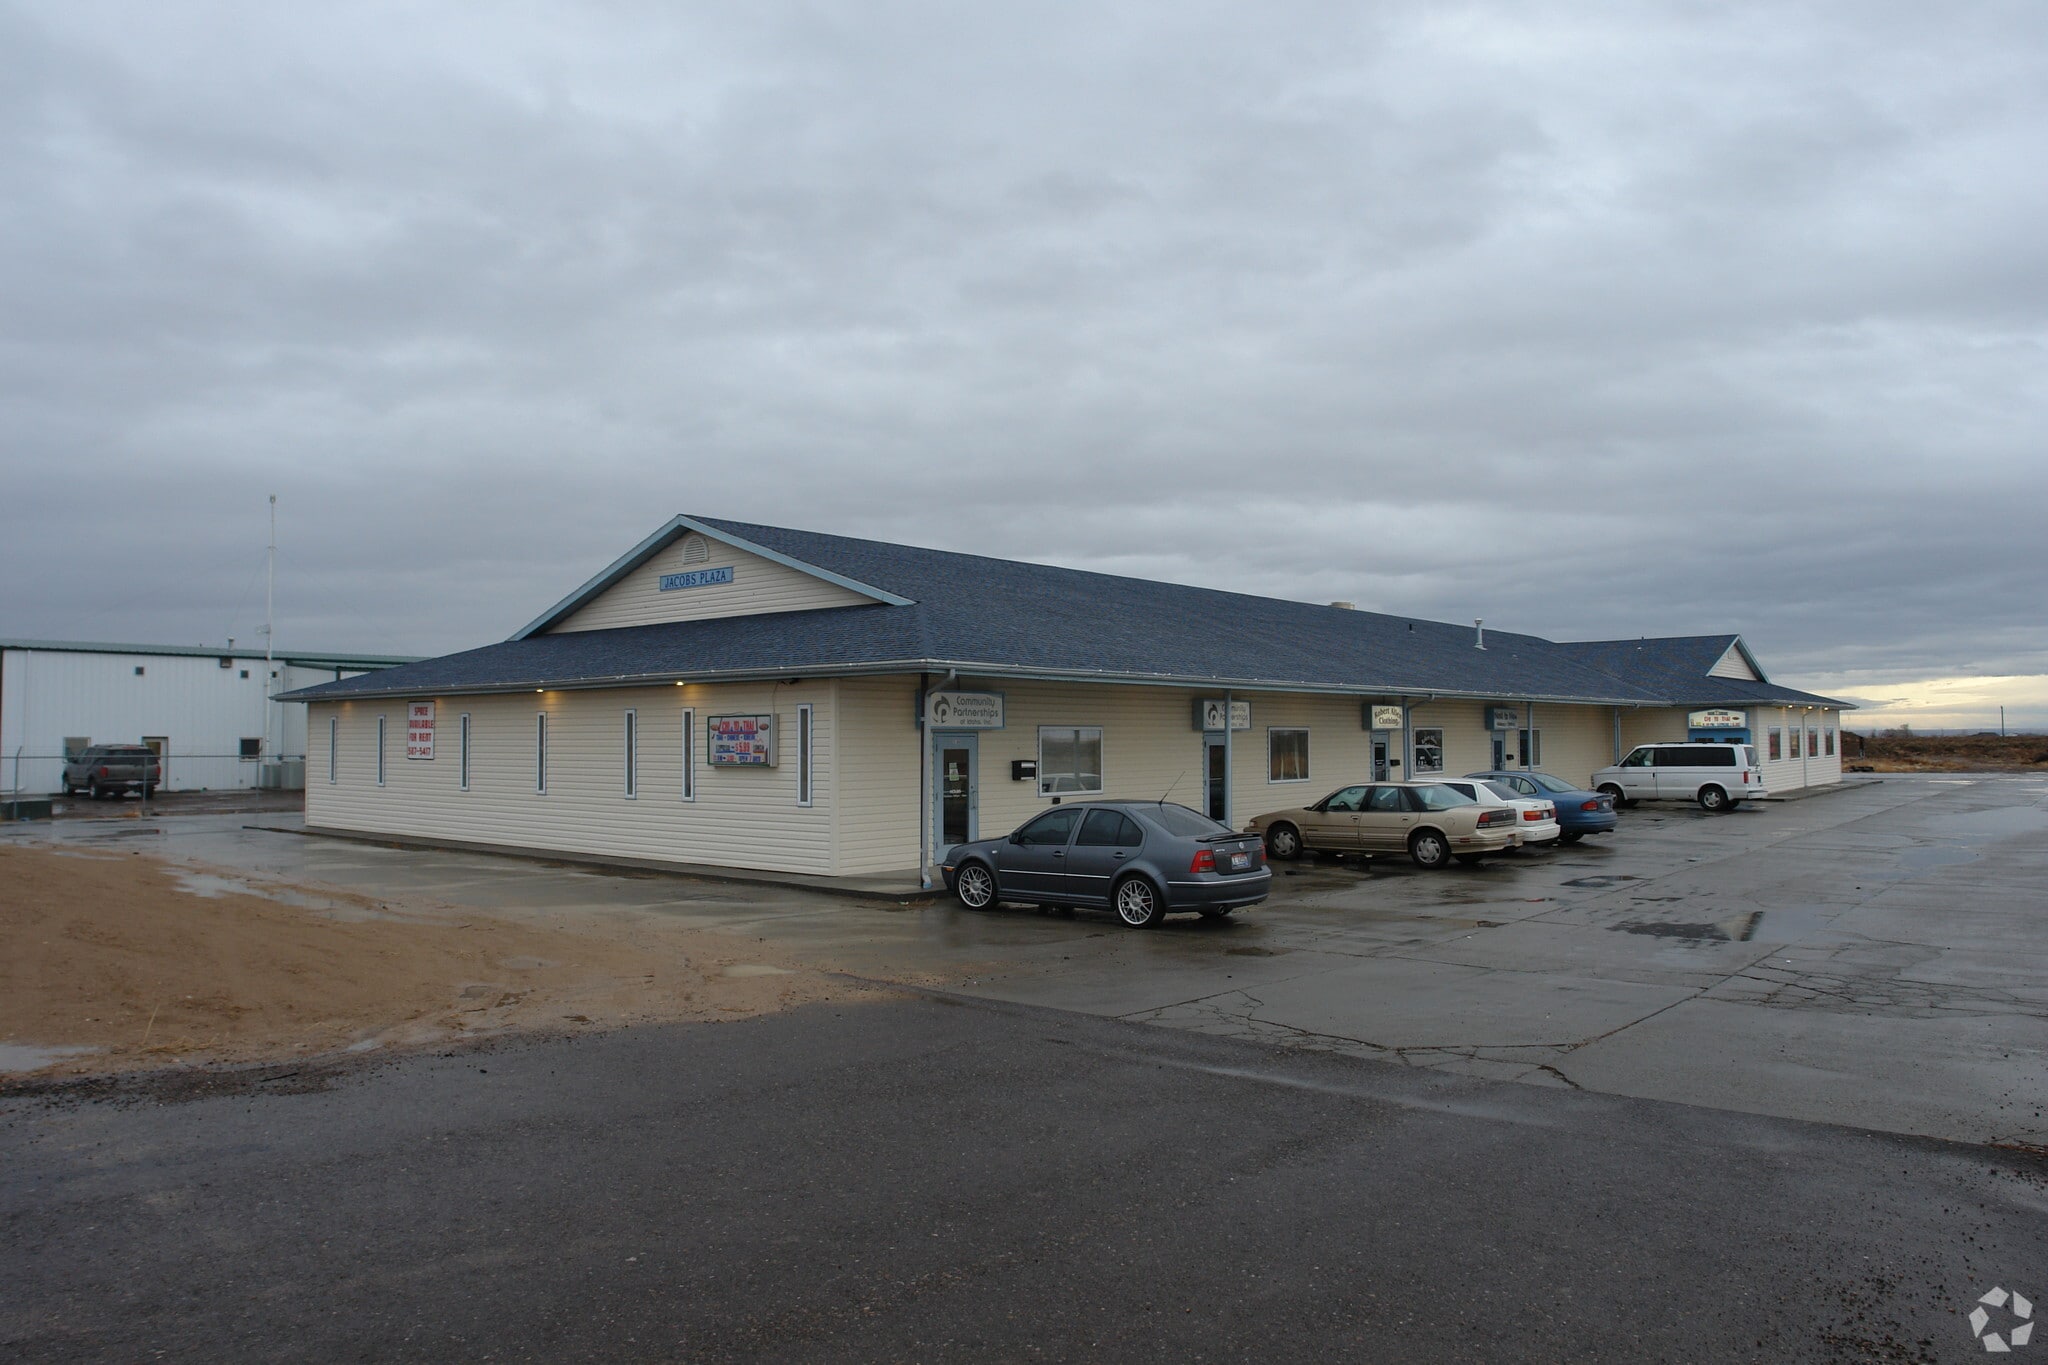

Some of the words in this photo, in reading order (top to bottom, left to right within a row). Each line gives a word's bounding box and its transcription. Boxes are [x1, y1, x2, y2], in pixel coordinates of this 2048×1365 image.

[665, 574, 697, 588] JACOBS
[700, 570, 726, 584] PLAZA
[956, 696, 996, 708] Community
[415, 706, 428, 716] SPACE
[953, 707, 999, 719] Partnerships
[409, 720, 434, 729] AVAILABLE
[409, 733, 417, 742] FOR
[419, 733, 432, 742] RENT
